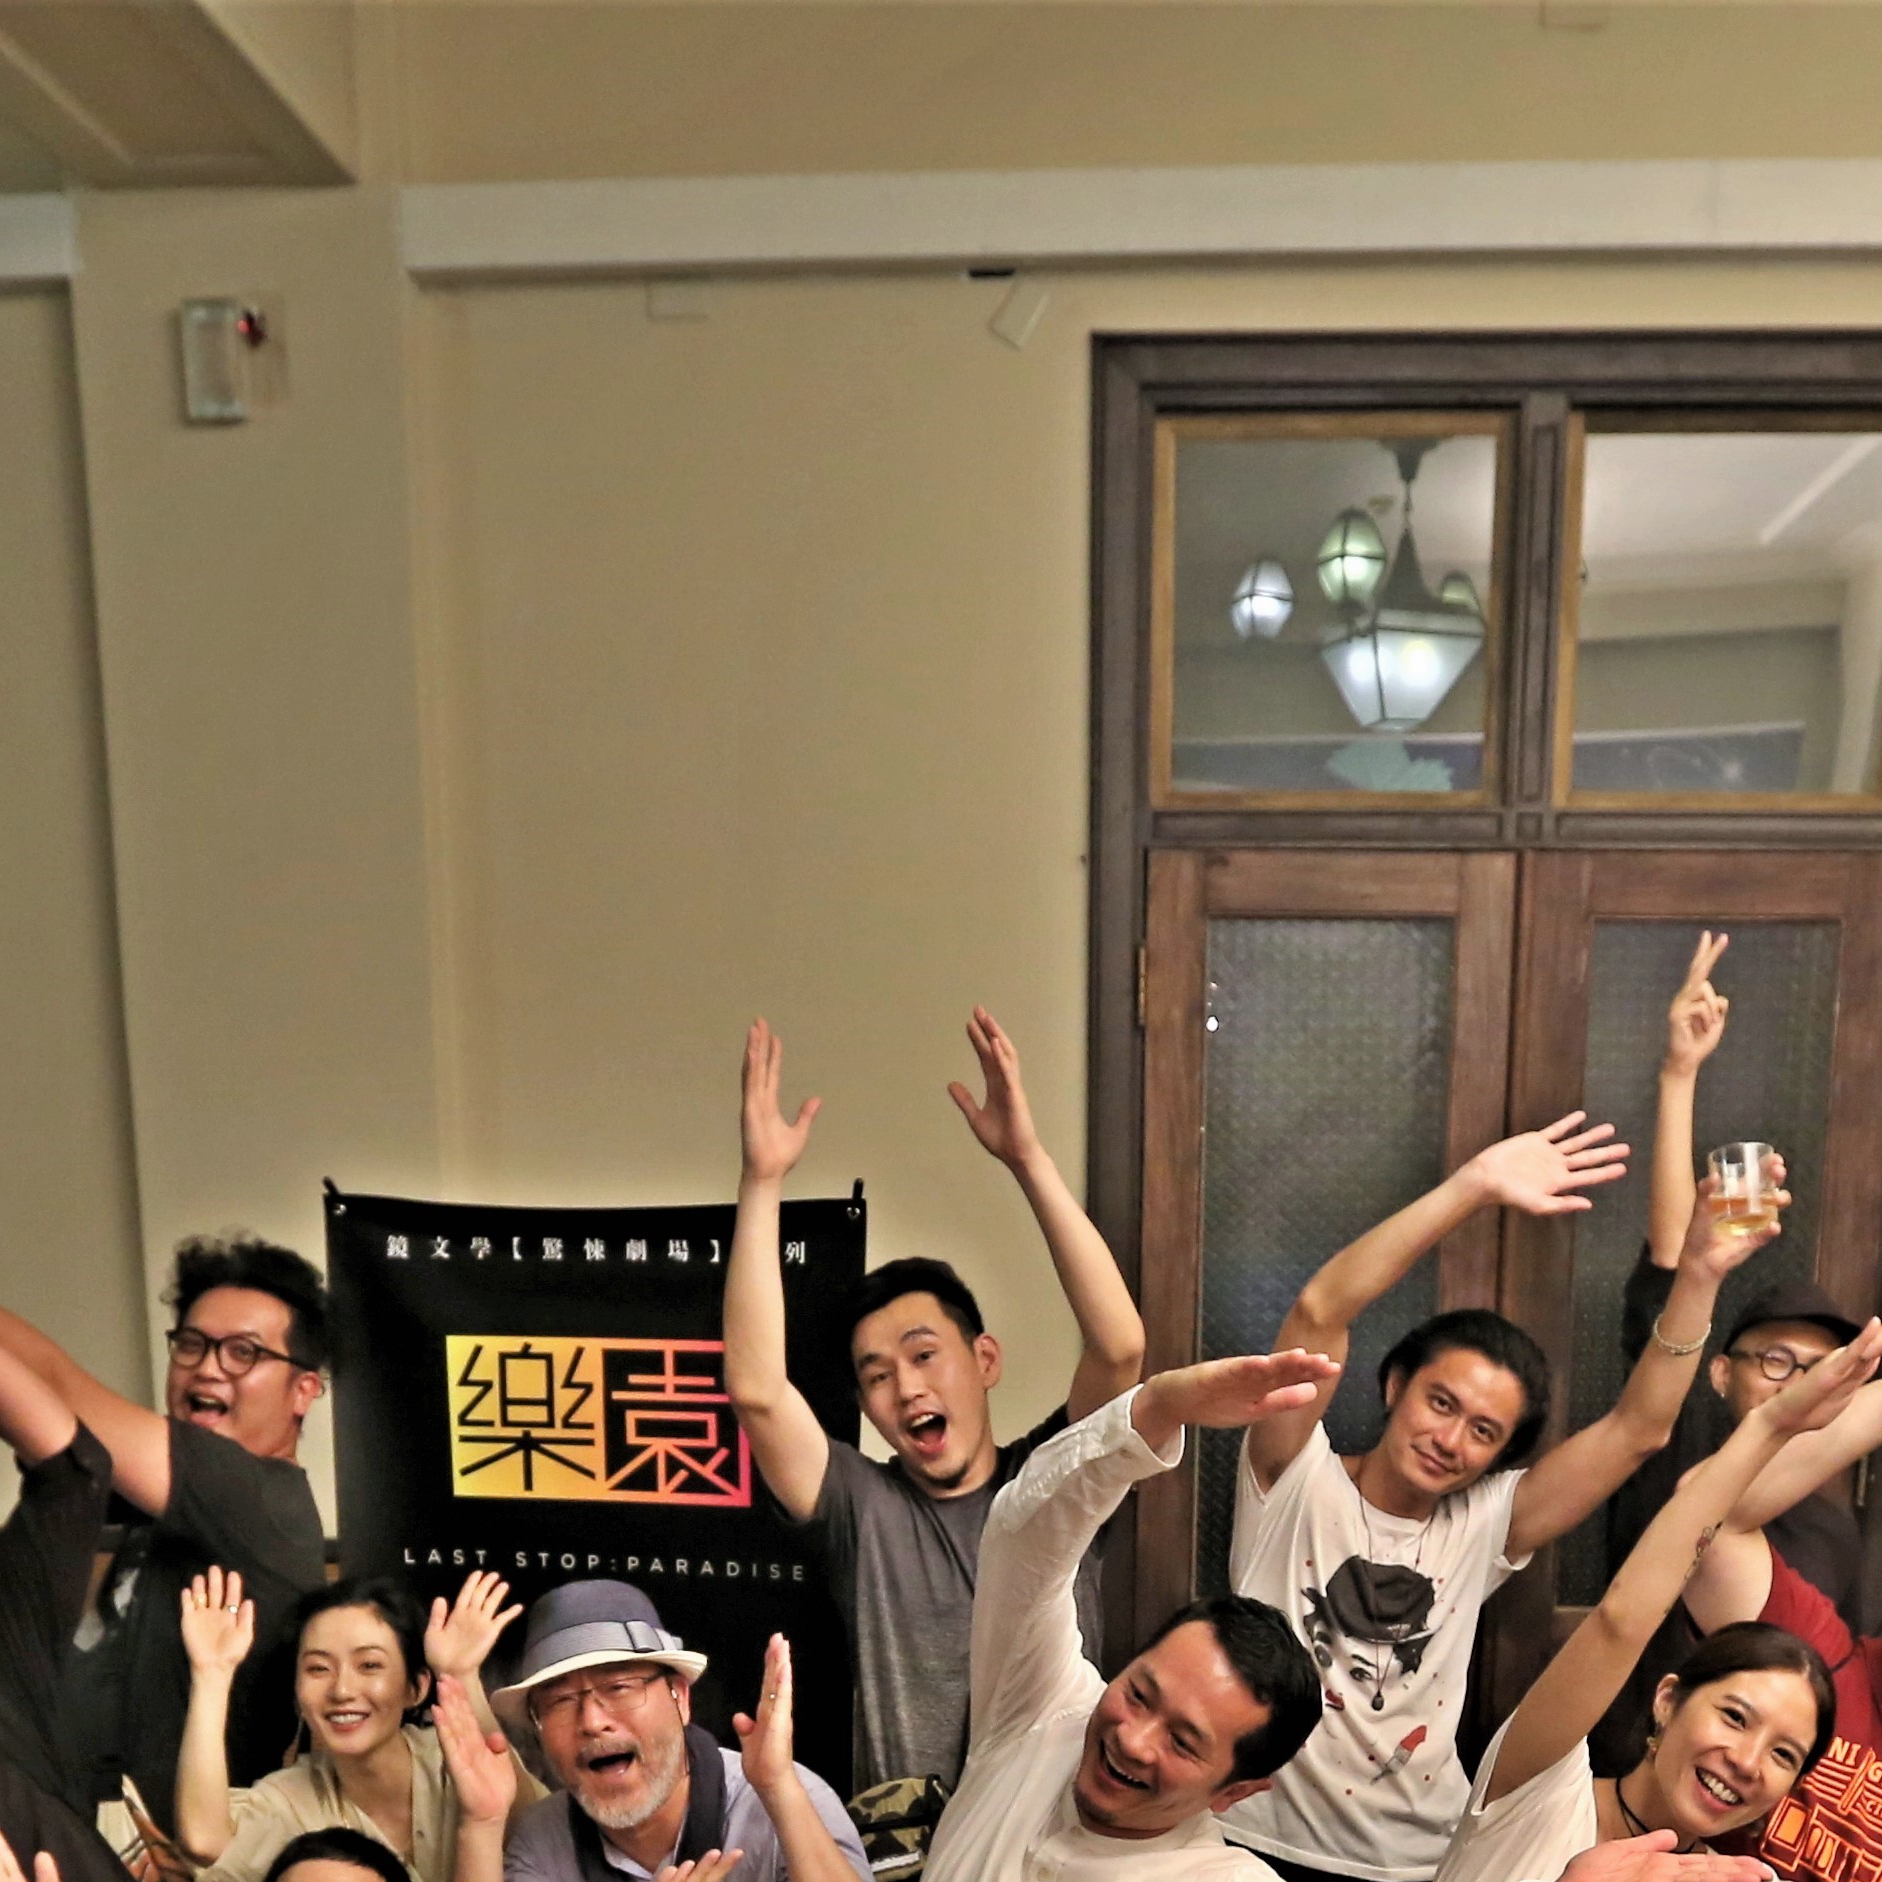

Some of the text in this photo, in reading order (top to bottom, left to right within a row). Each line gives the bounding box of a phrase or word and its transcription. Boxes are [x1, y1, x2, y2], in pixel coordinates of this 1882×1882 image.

[386, 1234, 807, 1265] 鏡文學【驚悚劇場】列
[446, 1335, 751, 1506] 樂園
[404, 1548, 487, 1566] LAST
